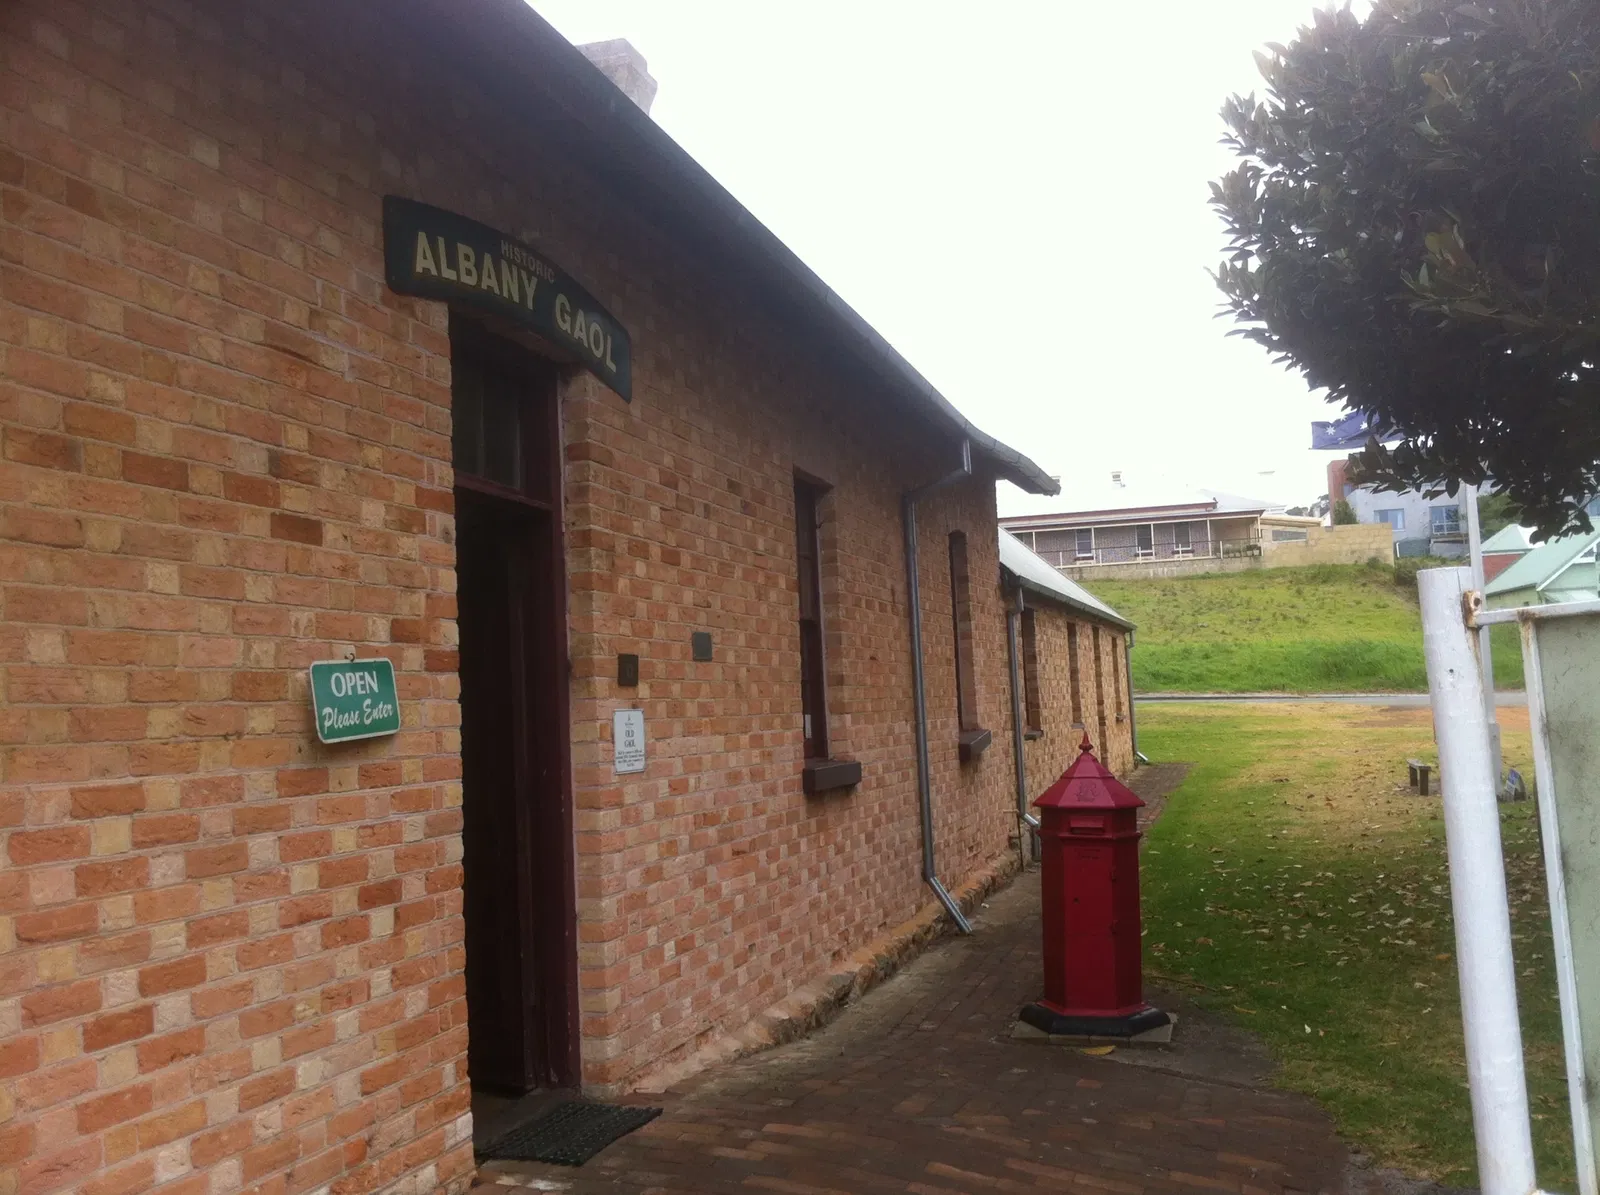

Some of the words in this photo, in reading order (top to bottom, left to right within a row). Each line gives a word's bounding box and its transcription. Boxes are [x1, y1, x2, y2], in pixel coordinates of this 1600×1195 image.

[500, 239, 556, 284] HISTORIC
[415, 231, 538, 310] ALBANY
[555, 293, 617, 373] GAOL
[330, 670, 379, 697] OPEN
[322, 706, 360, 734] Please
[363, 698, 393, 725] Enter
[625, 730, 635, 738] OLD
